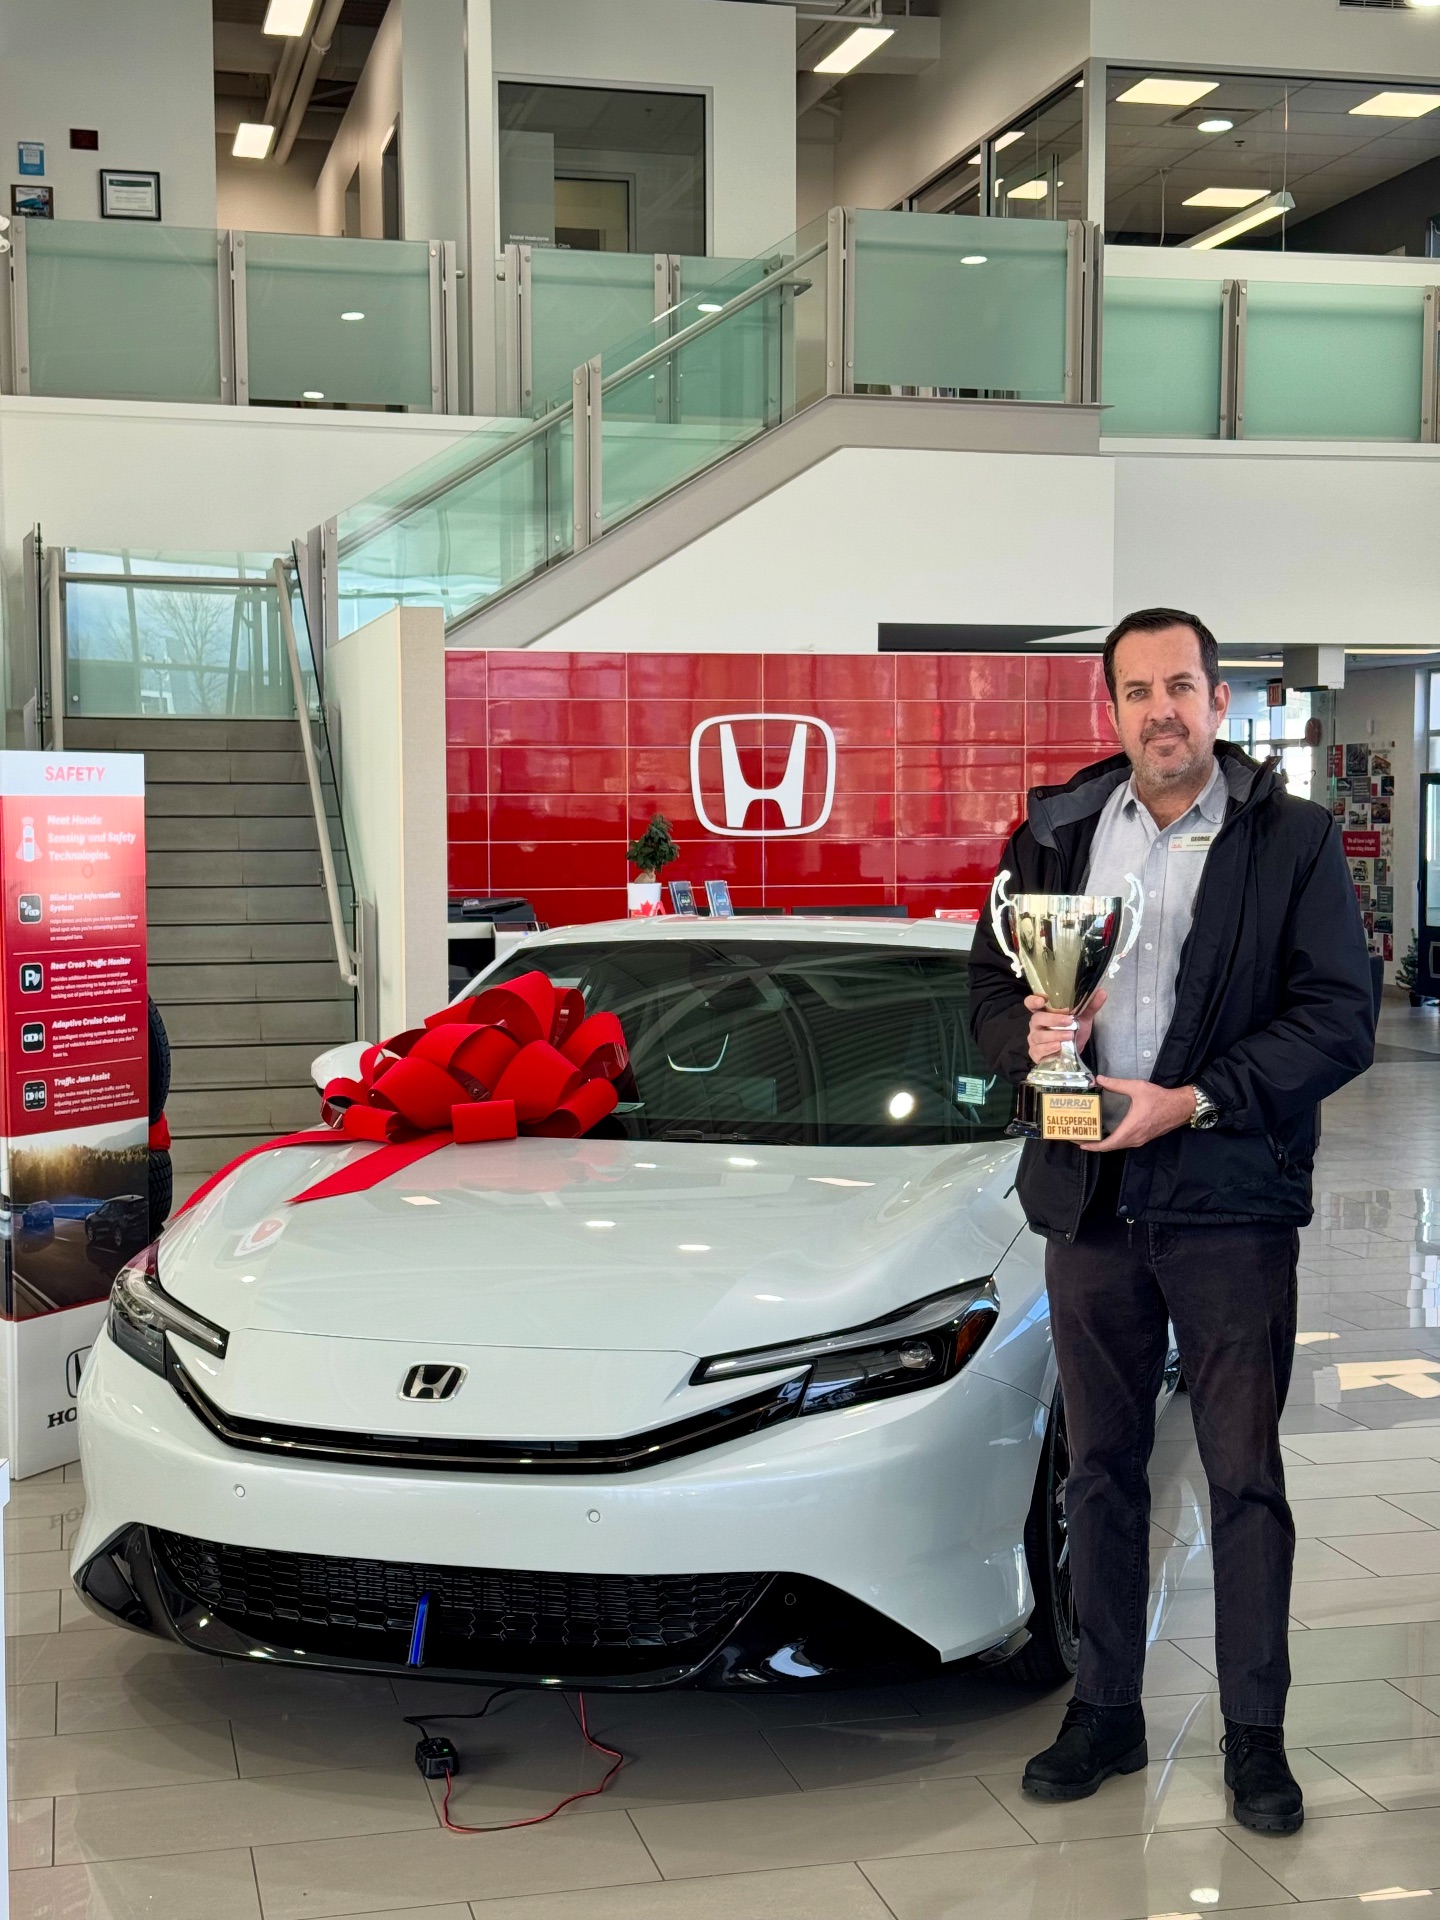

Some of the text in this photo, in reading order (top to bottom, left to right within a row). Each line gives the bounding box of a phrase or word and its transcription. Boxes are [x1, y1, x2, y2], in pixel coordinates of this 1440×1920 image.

[45, 766, 106, 781] SAFETY
[48, 815, 70, 825] Meet
[48, 832, 136, 844] Sensing and Safety
[49, 851, 111, 861] Technologies.
[50, 892, 120, 902] Blind Spot Information
[51, 962, 66, 970] Rear
[87, 959, 107, 968] Traffic
[108, 957, 131, 965] Monitor
[52, 1014, 126, 1029] Adaptive Cruise Control
[54, 1072, 110, 1087] Traffic Jam Assist
[1050, 1098, 1094, 1108] MURRAY
[1047, 1116, 1097, 1126] SALESPERSON
[1048, 1126, 1097, 1135] OF THE MONTH
